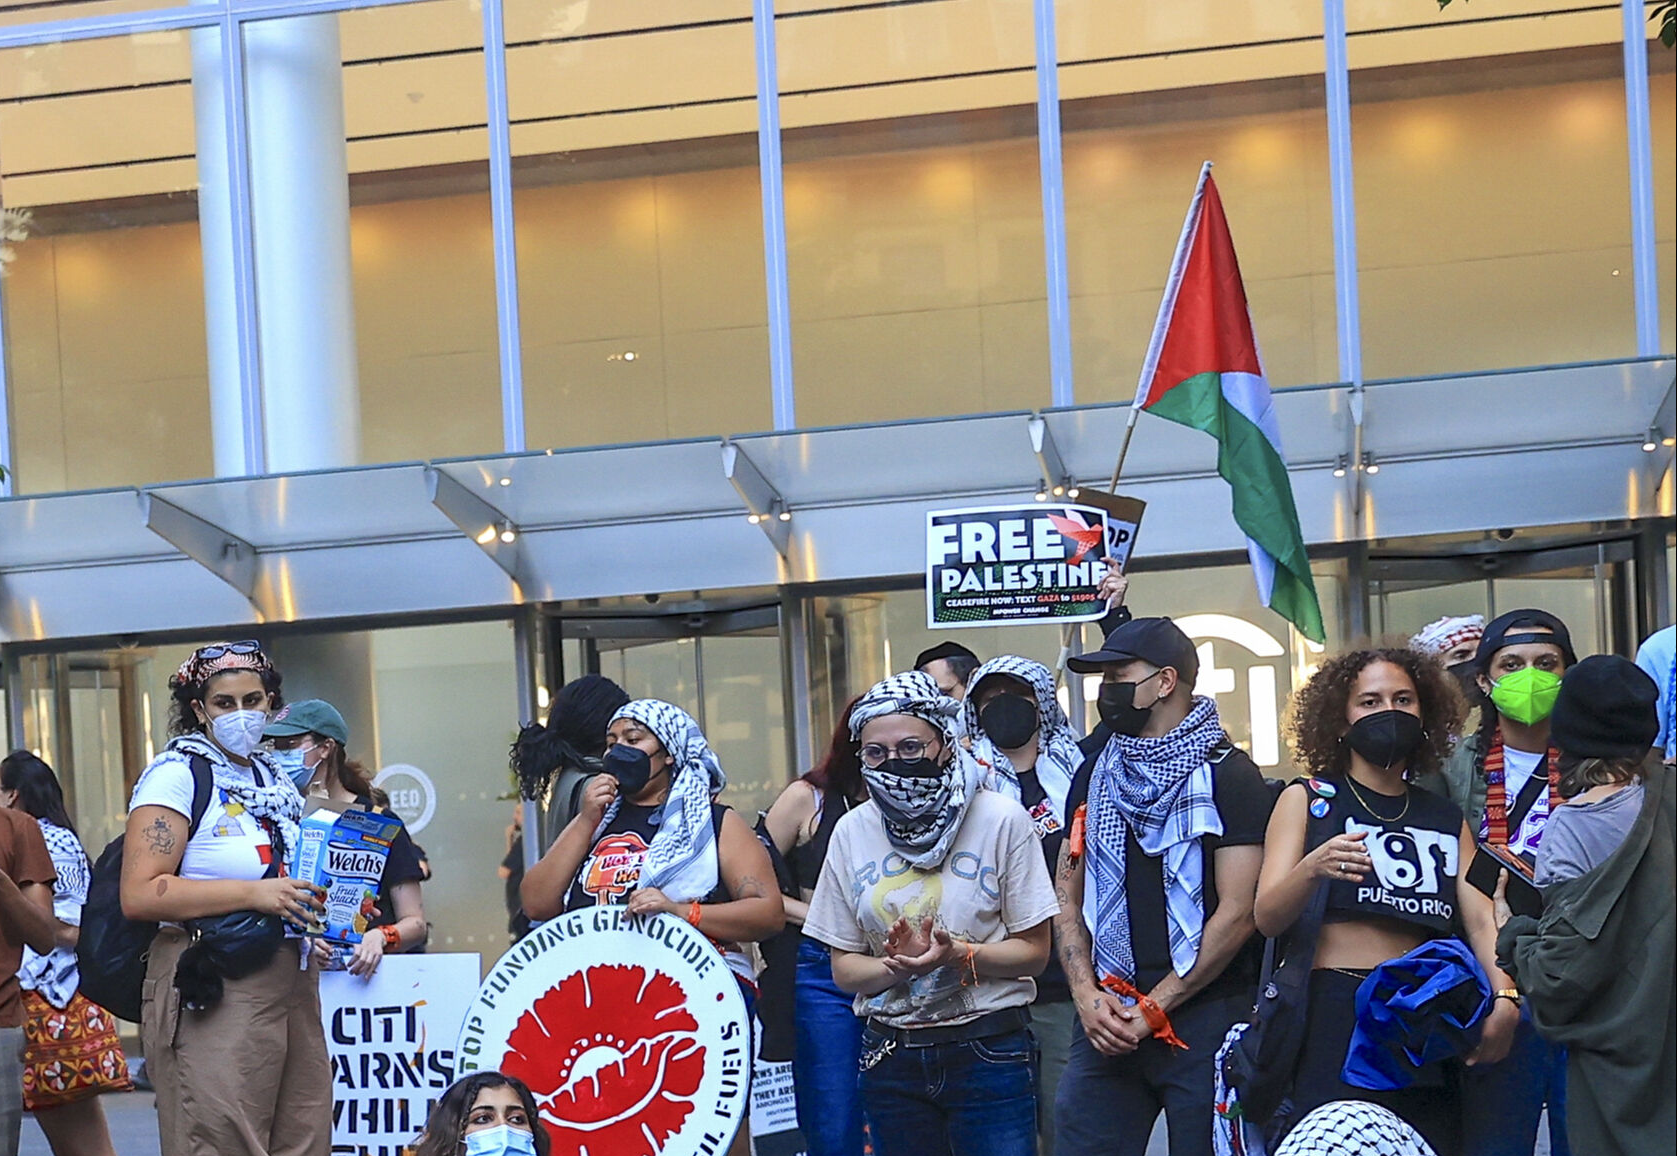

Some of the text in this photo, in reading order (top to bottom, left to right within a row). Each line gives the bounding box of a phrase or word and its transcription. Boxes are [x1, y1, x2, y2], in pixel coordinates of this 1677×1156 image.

[932, 517, 1065, 565] FREE
[945, 596, 991, 607] CEASEFIRE
[1015, 595, 1037, 604] TEXT
[1037, 594, 1060, 603] GAZA
[1060, 593, 1070, 602] to
[329, 850, 384, 875] Welch's
[327, 892, 360, 906] Snacks
[336, 886, 359, 897] Fruit
[1422, 898, 1453, 920] RICO
[481, 914, 584, 1009] FUNDING
[331, 1006, 416, 1045] CITI
[459, 1016, 486, 1074] TOP
[329, 1050, 454, 1089] ARNS
[715, 1020, 741, 1118] FUELS
[753, 1089, 776, 1101] THEY
